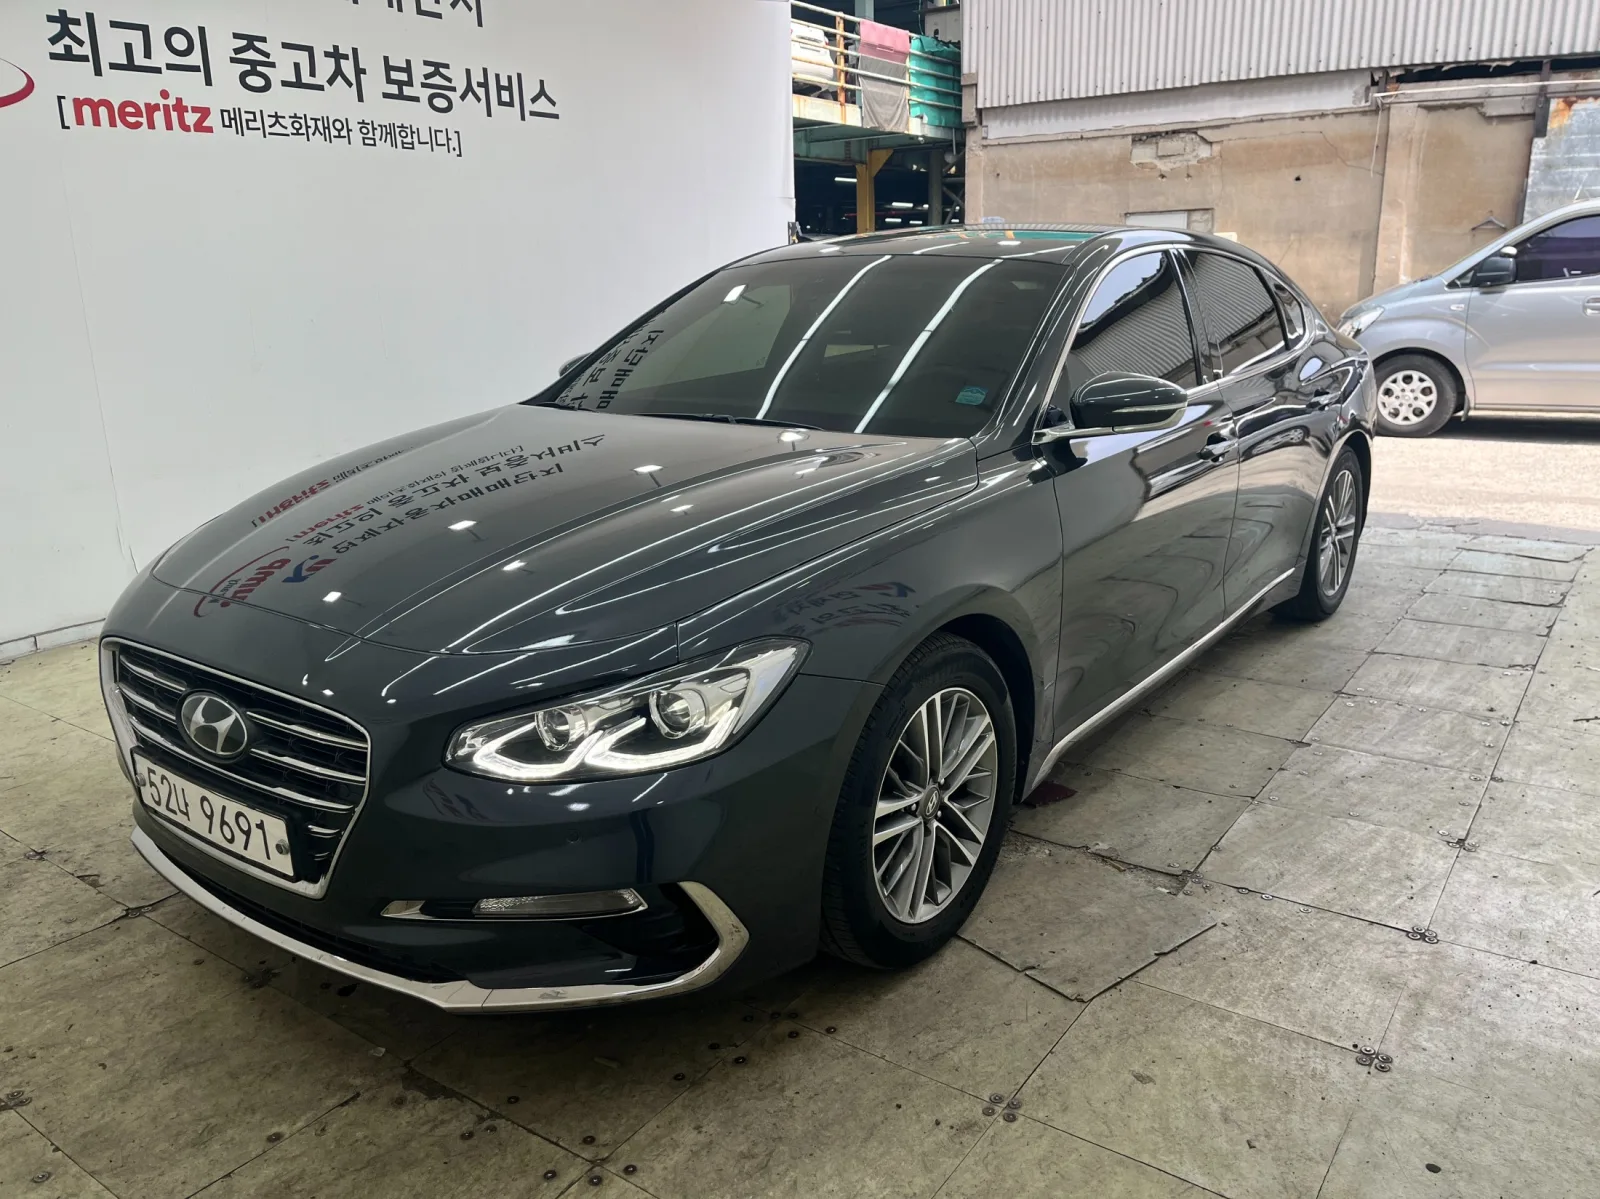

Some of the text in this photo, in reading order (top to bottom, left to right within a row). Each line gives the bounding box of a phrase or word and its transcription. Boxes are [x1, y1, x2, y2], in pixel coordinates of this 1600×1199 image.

[45, 8, 561, 121] 최고의 중고차 보증서비스
[220, 108, 352, 146] 메리츠화재와
[357, 119, 463, 157] 함께합니다.]
[147, 766, 271, 860] 52나 9691
